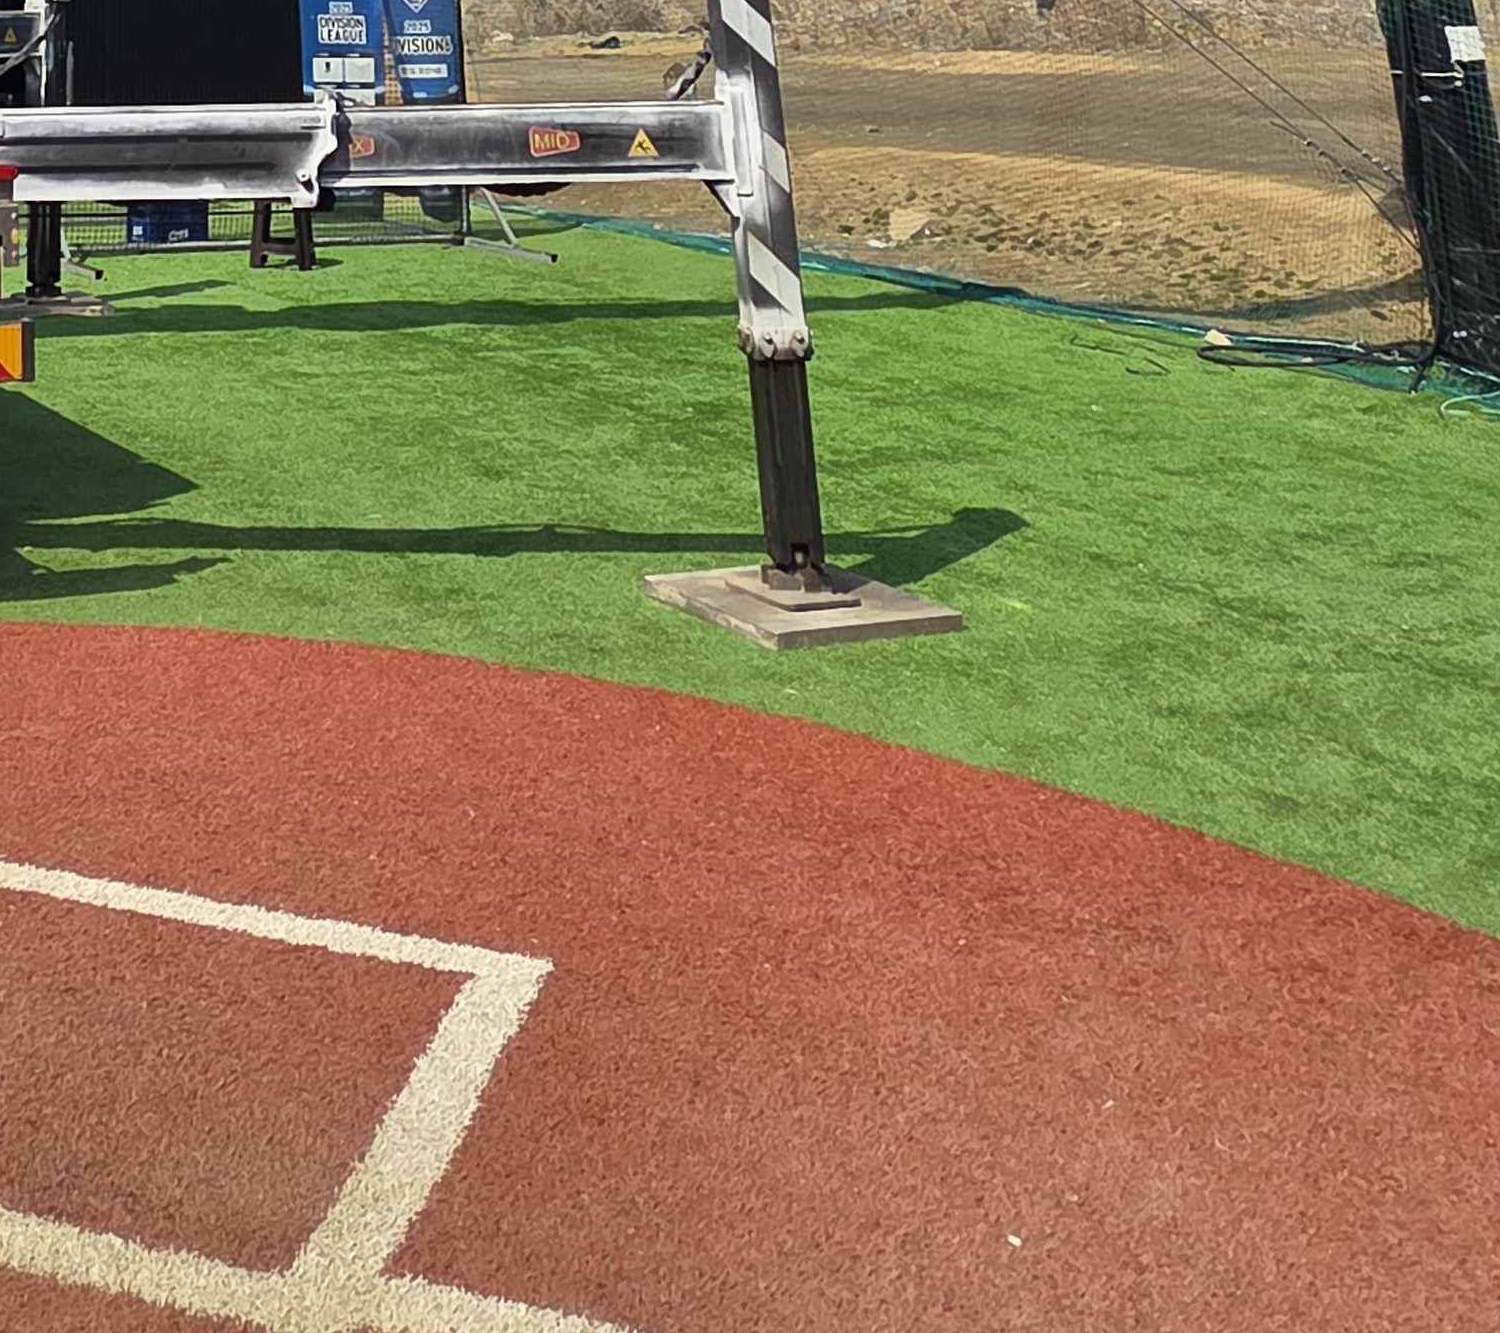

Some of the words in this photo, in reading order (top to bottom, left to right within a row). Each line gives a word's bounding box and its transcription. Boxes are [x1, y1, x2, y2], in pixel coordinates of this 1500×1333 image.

[319, 16, 364, 29] DIVISION
[320, 28, 364, 42] LEAGUE
[534, 132, 570, 151] MID
